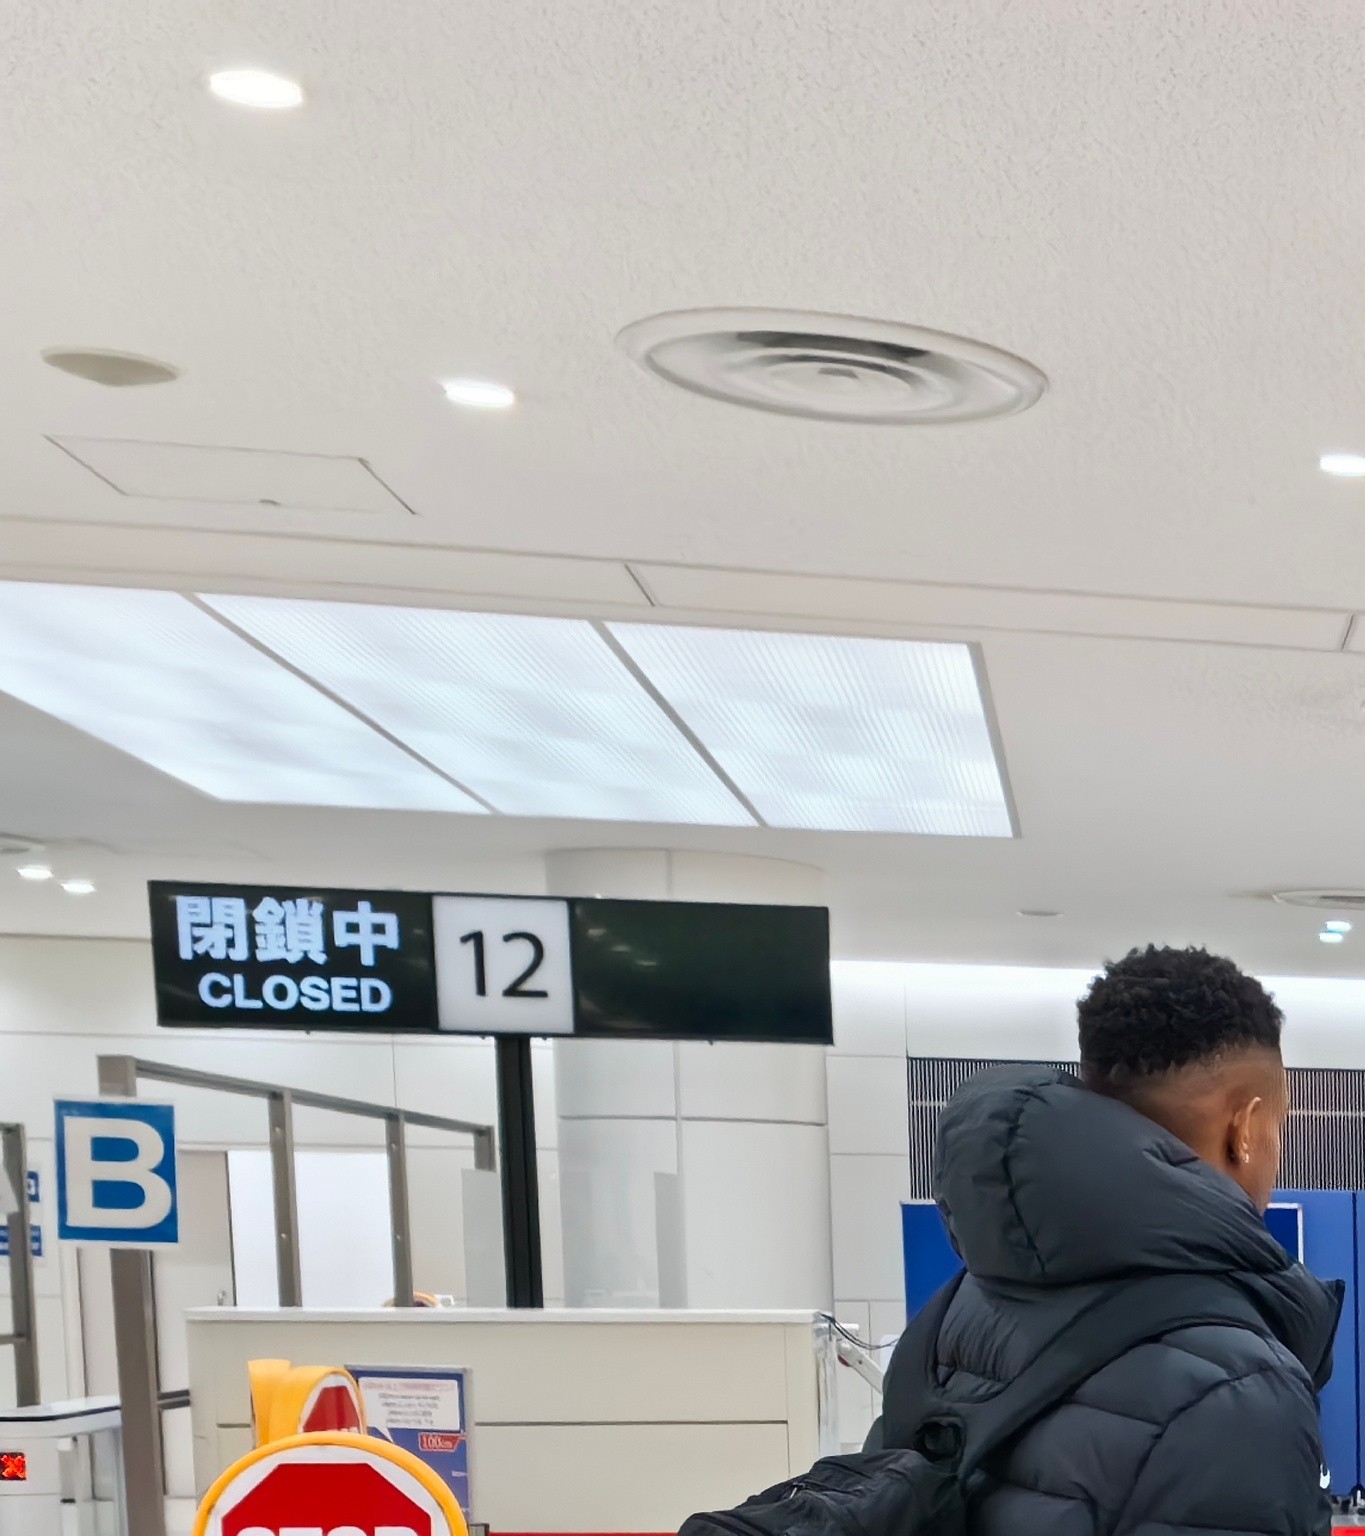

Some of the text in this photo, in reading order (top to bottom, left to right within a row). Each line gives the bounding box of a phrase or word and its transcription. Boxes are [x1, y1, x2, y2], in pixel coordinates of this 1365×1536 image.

[175, 895, 400, 967] 閉鎖中
[460, 930, 549, 999] 12
[198, 972, 392, 1013] CLOSED
[64, 1115, 173, 1229] B
